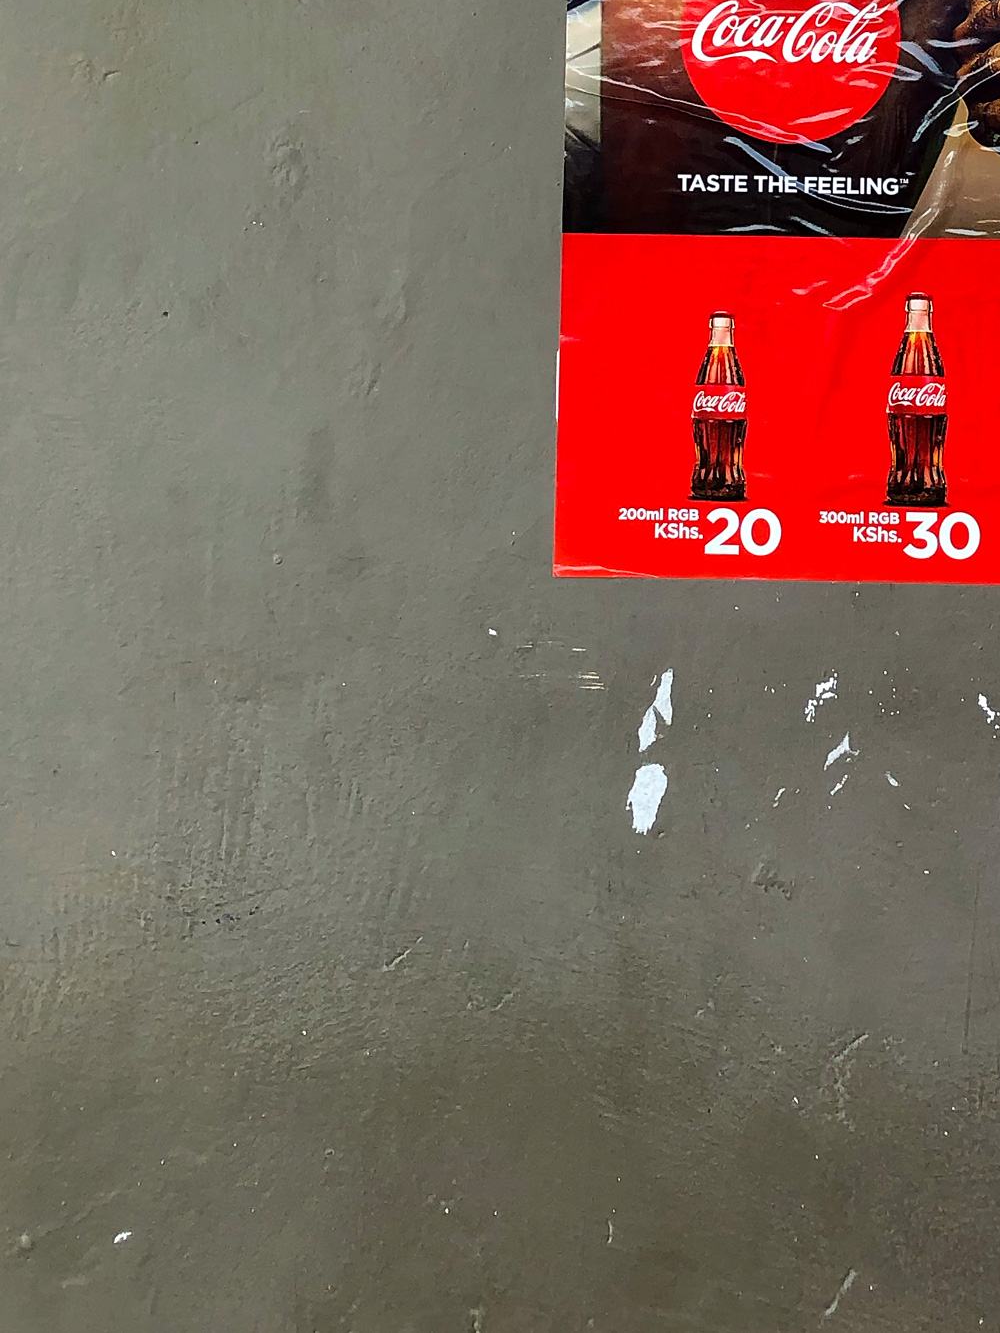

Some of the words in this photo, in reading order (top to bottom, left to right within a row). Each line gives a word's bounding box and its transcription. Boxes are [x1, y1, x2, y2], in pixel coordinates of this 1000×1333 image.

[691, 0, 884, 64] Coca-Cola
[677, 174, 748, 193] TASTE
[753, 175, 798, 194] THE
[693, 390, 747, 413] Coca-Cola
[888, 382, 947, 407] Coca-Cola
[618, 507, 664, 521] 200ml
[668, 508, 700, 522] RGB
[819, 510, 865, 525] 300ml
[868, 511, 900, 525] RGB
[654, 523, 704, 540] KShs.
[704, 507, 782, 556] 20
[853, 526, 903, 543] KShs.
[903, 511, 981, 560] 30
